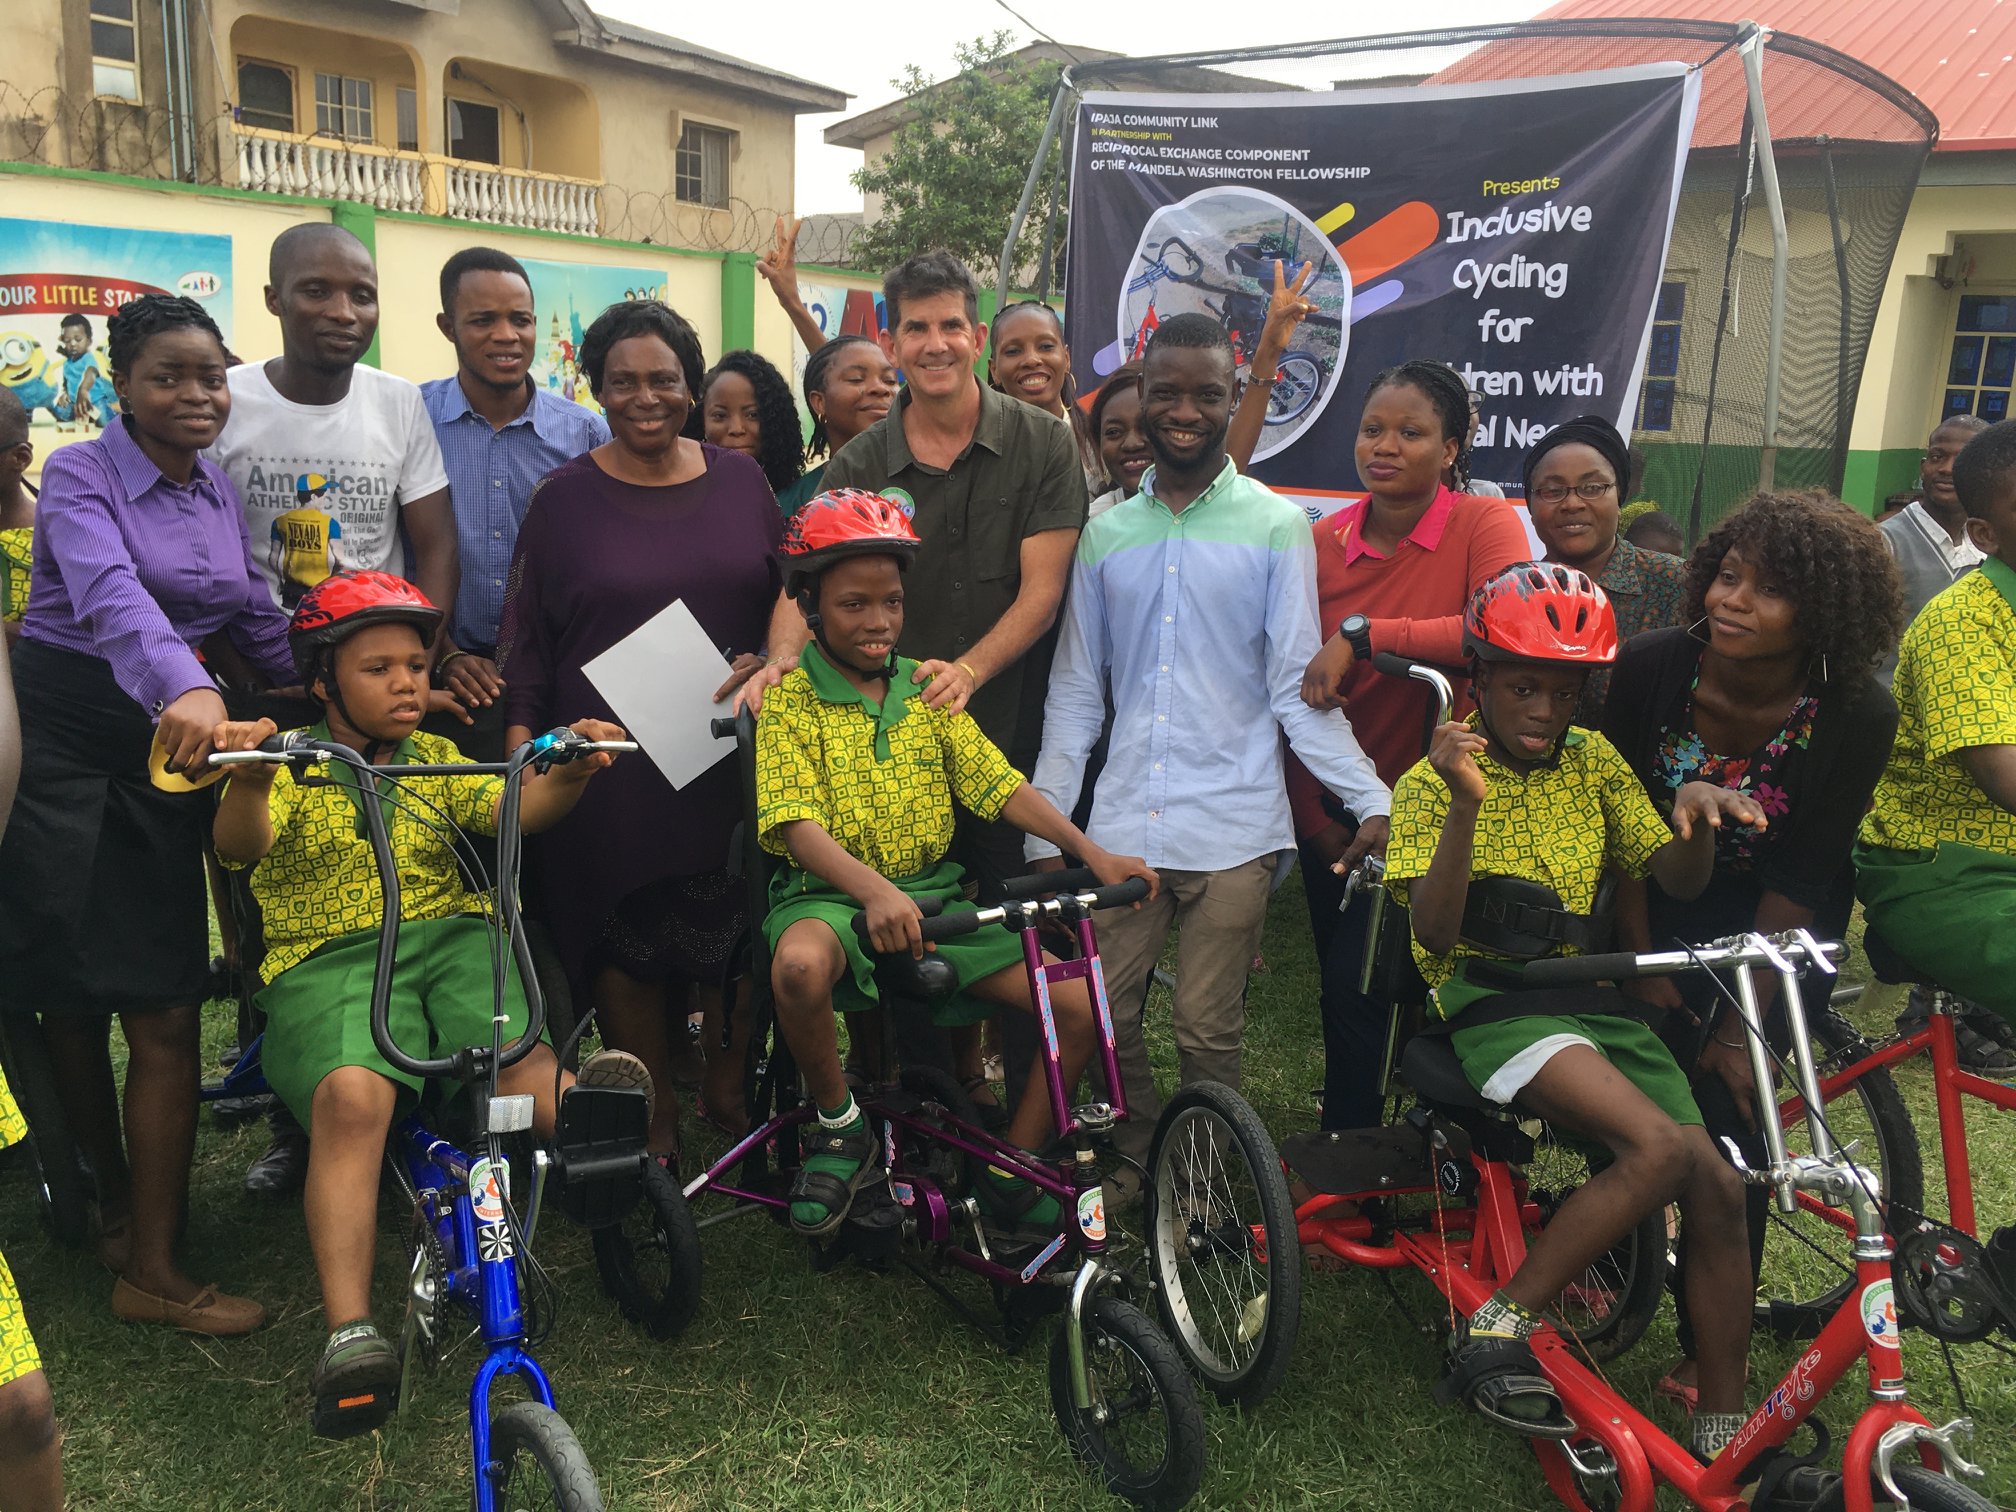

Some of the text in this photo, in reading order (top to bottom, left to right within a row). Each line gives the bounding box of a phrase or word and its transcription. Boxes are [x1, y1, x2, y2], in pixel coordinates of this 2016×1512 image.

[1091, 112, 1219, 128] IPAJA COMMUNITY LINK
[1091, 128, 1172, 141] IN PARTNERSHIP WITH
[1091, 142, 1311, 161] RECIPROCAL EXCHANGE COMPONENT
[1090, 160, 1371, 180] OF THE MANDELA WASHINGTON FELLOWSHIP
[1483, 176, 1561, 197] Presents
[1445, 200, 1593, 244] Inclusive
[1452, 253, 1569, 300] Cycling
[43, 285, 98, 306] LITTLE
[1478, 309, 1534, 342] for
[1532, 362, 1604, 396] with
[246, 464, 389, 496] Amican
[338, 497, 387, 511] STYLE
[340, 511, 384, 524] ORIGINAL
[288, 522, 321, 541] NEVADA
[288, 539, 321, 550] BOYS
